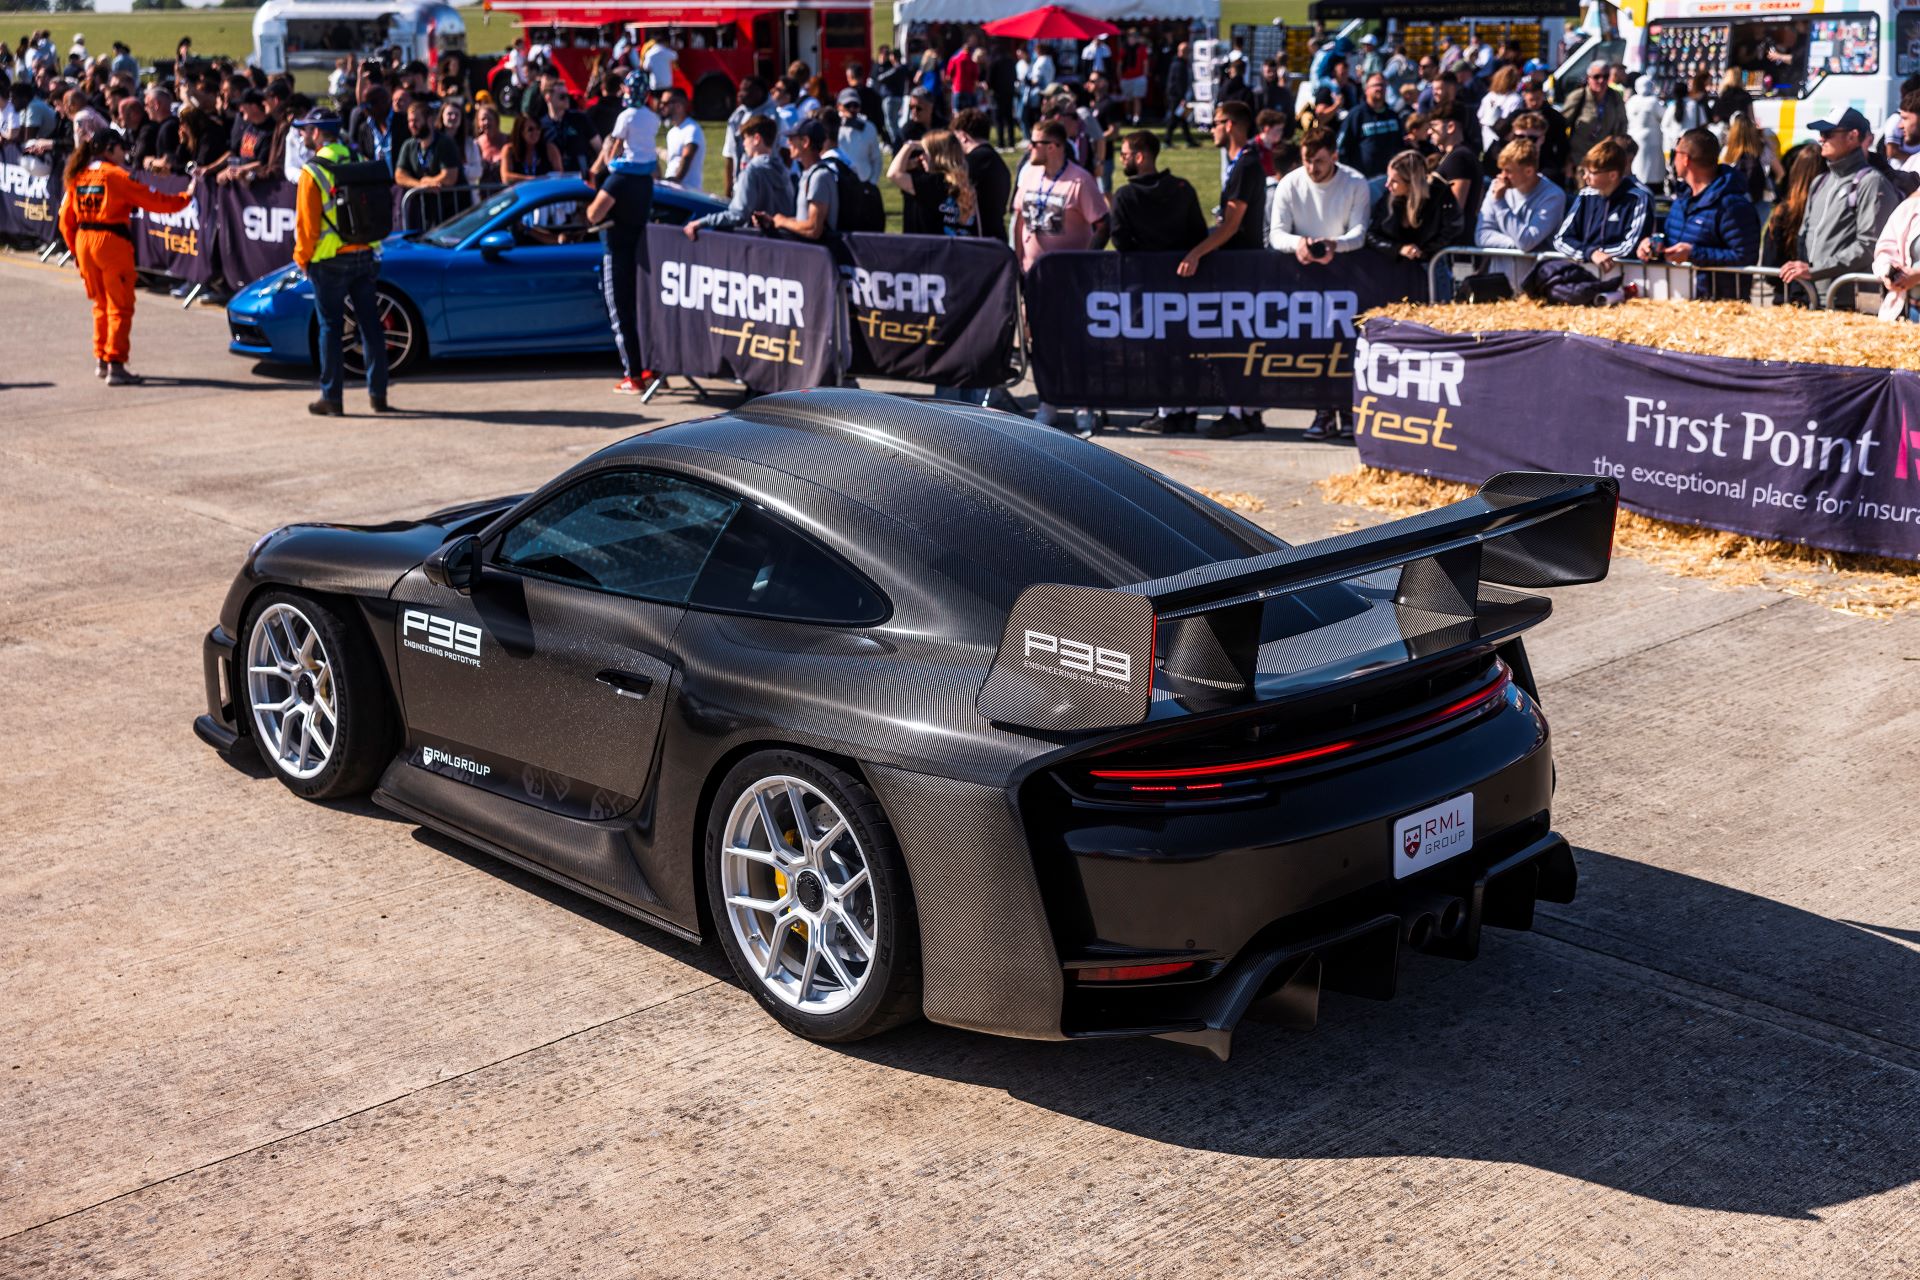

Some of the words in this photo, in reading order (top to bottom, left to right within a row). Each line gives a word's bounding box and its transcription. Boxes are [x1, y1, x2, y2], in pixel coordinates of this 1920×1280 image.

[1759, 2, 1801, 10] CREAM
[148, 226, 199, 256] fest
[243, 206, 297, 242] SUP
[660, 261, 804, 327] SUPERCAR
[857, 310, 945, 345] fest
[1086, 291, 1358, 339] SUPERCAR
[711, 322, 804, 365] fest
[1190, 342, 1353, 377] fest
[1352, 396, 1458, 451] fest
[1624, 396, 1730, 457] First
[1741, 412, 1880, 476] Point
[1593, 456, 1626, 479] the
[1631, 467, 1746, 500] exceptional
[1752, 484, 1808, 510] place
[1816, 491, 1851, 514] for
[403, 609, 482, 656] P39
[403, 639, 443, 657] ENGINEERING
[444, 651, 481, 668] PROTOTYPE
[1025, 630, 1130, 682] P39
[1024, 661, 1078, 681] ENGINEERING
[1080, 675, 1130, 694] PROTOTYPE
[432, 750, 491, 776] RMLGROUP
[1425, 809, 1465, 839] RML
[1425, 830, 1465, 855] GROUP
